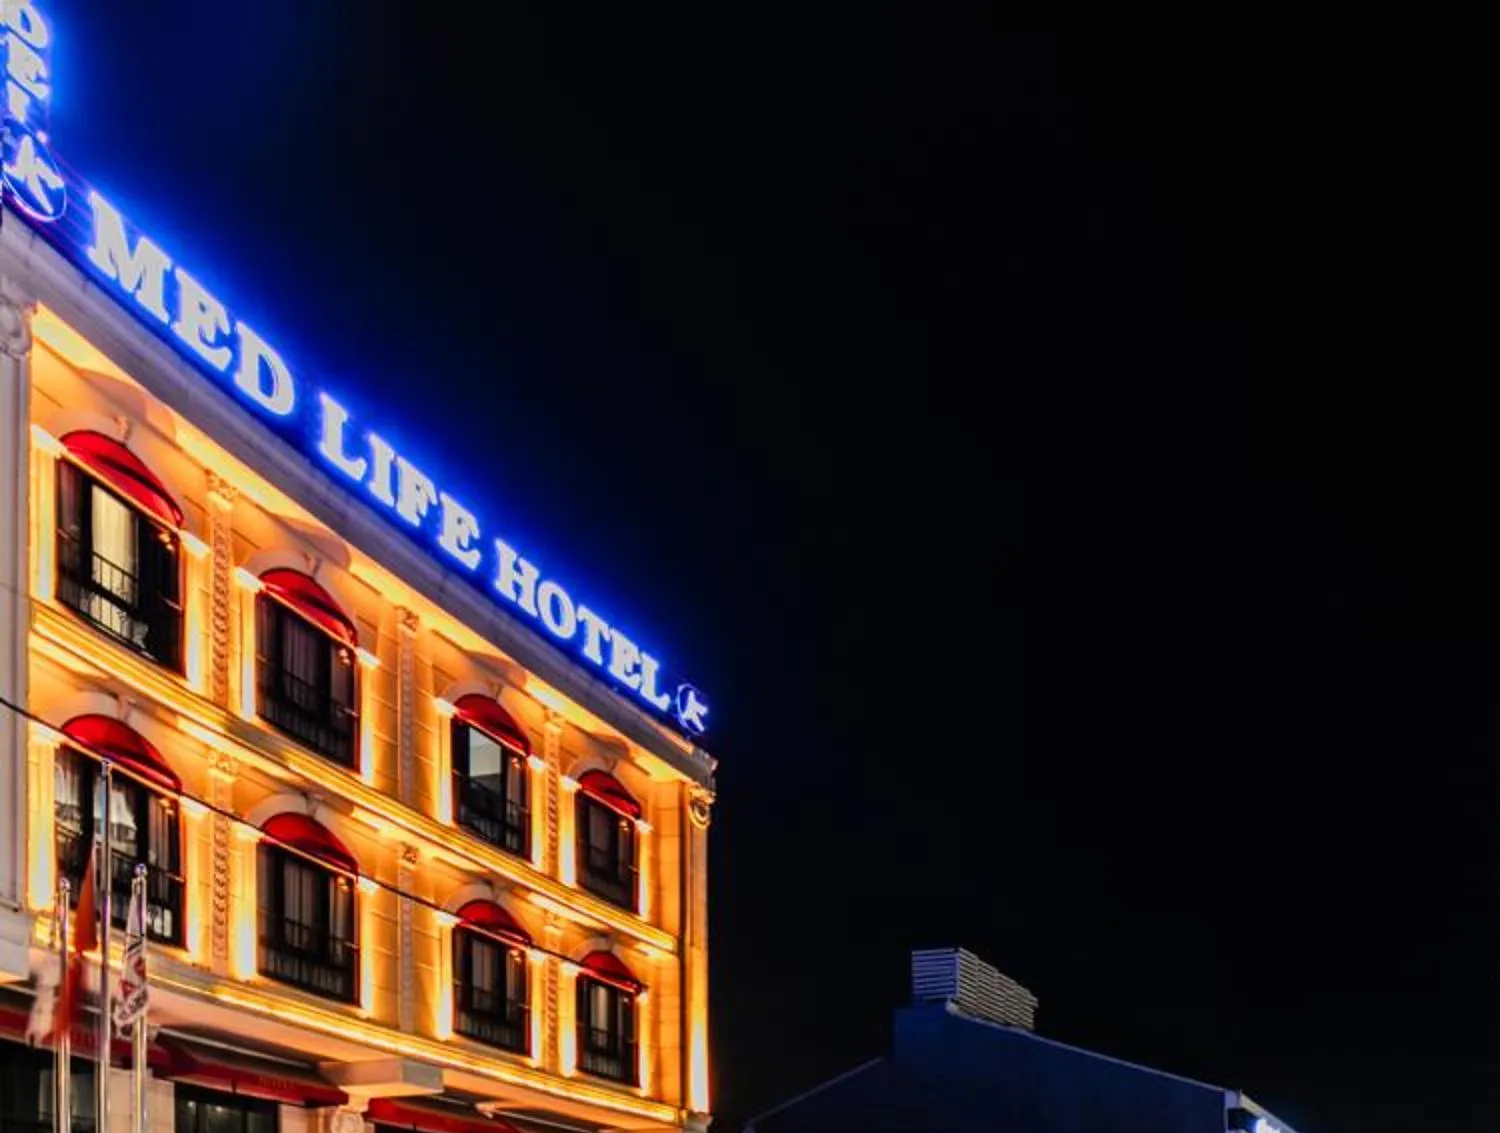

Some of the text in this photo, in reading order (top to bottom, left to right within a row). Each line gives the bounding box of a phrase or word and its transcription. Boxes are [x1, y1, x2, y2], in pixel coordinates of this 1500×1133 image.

[86, 190, 670, 711] MED LIFE HOTEL
